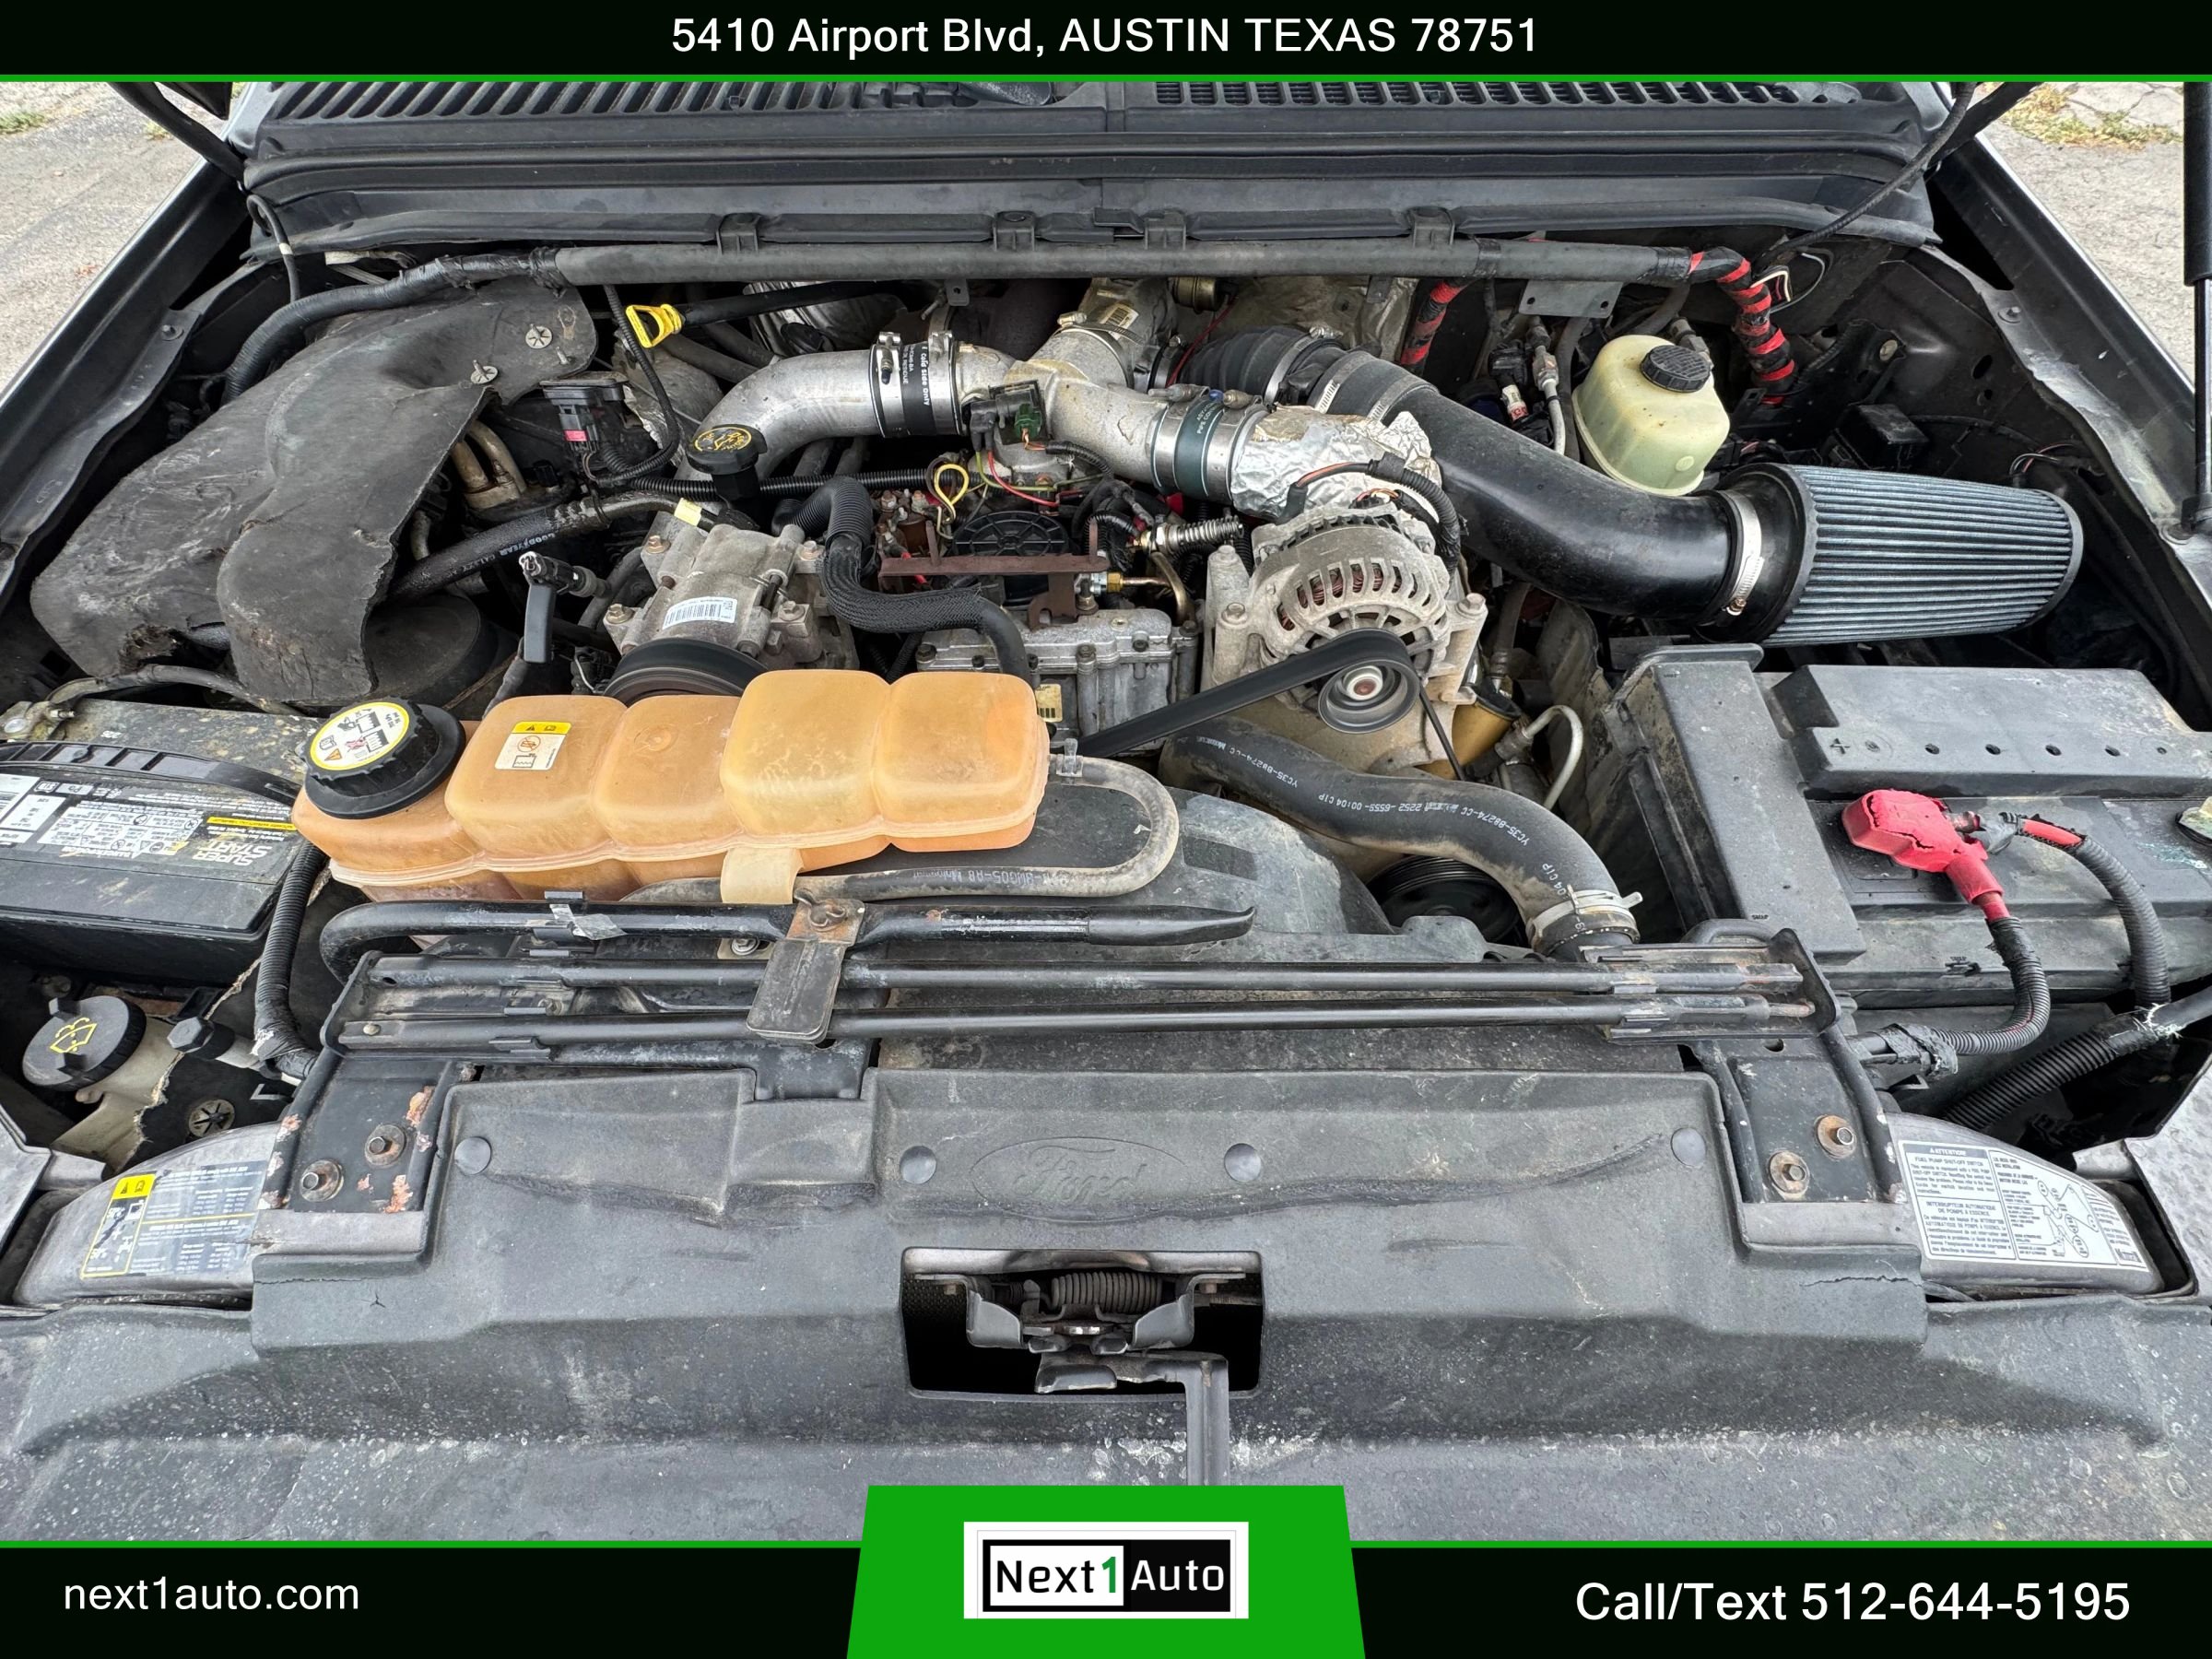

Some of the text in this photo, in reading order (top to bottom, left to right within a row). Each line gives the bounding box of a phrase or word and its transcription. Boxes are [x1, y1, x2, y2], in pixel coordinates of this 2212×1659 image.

[1397, 802, 1422, 812] 2252
[192, 850, 254, 866] SUPER
[198, 839, 273, 859] START
[1012, 1143, 1149, 1206] Ford
